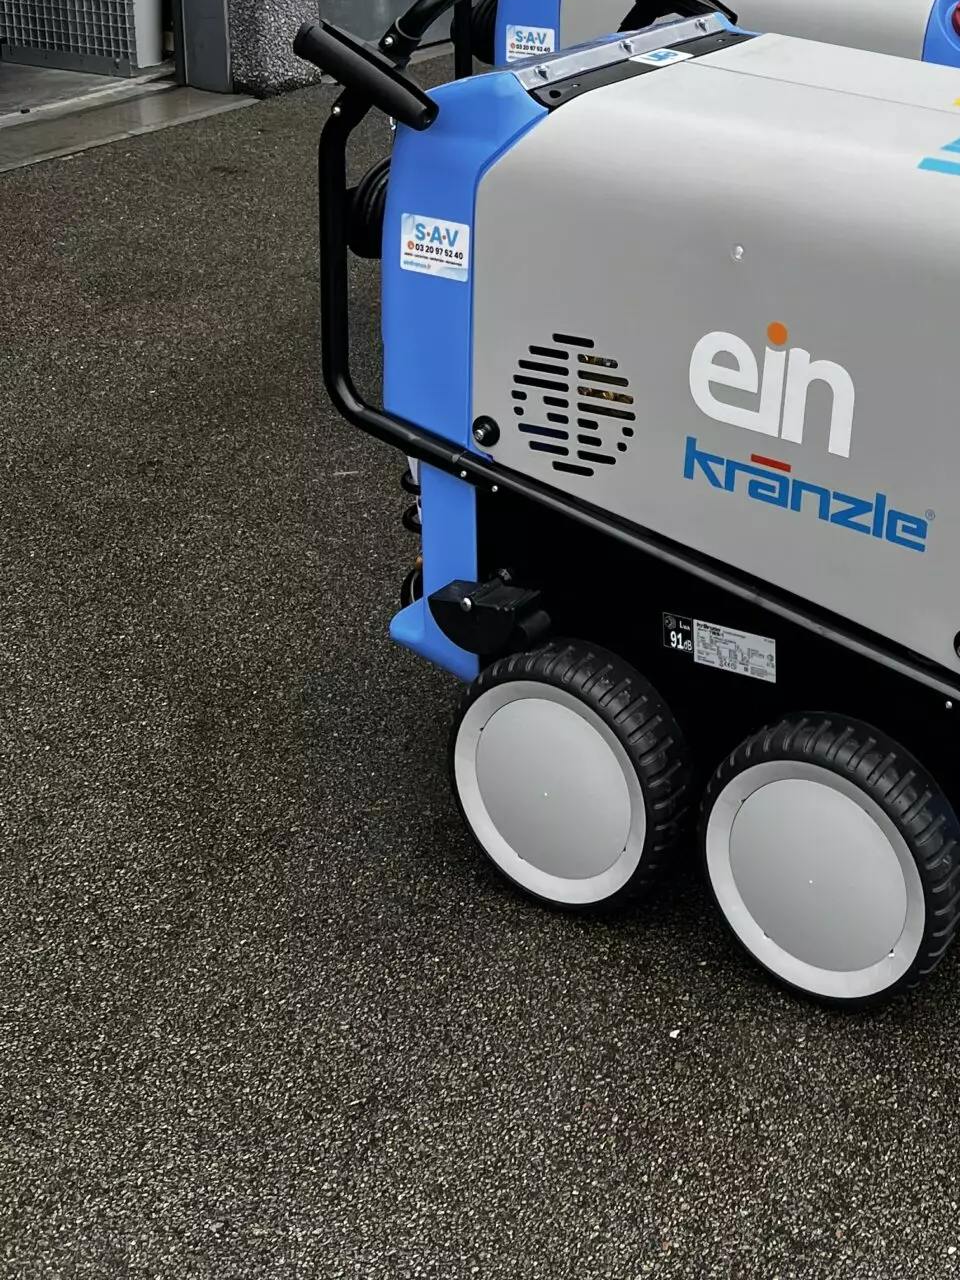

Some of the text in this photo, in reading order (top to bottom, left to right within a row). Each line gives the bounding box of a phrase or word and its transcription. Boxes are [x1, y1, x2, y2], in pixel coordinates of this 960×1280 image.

[415, 243, 424, 252] 03
[425, 245, 434, 254] 20
[435, 247, 444, 256] 97
[444, 249, 453, 258] 52
[454, 252, 464, 260] 40
[688, 321, 856, 459] ein
